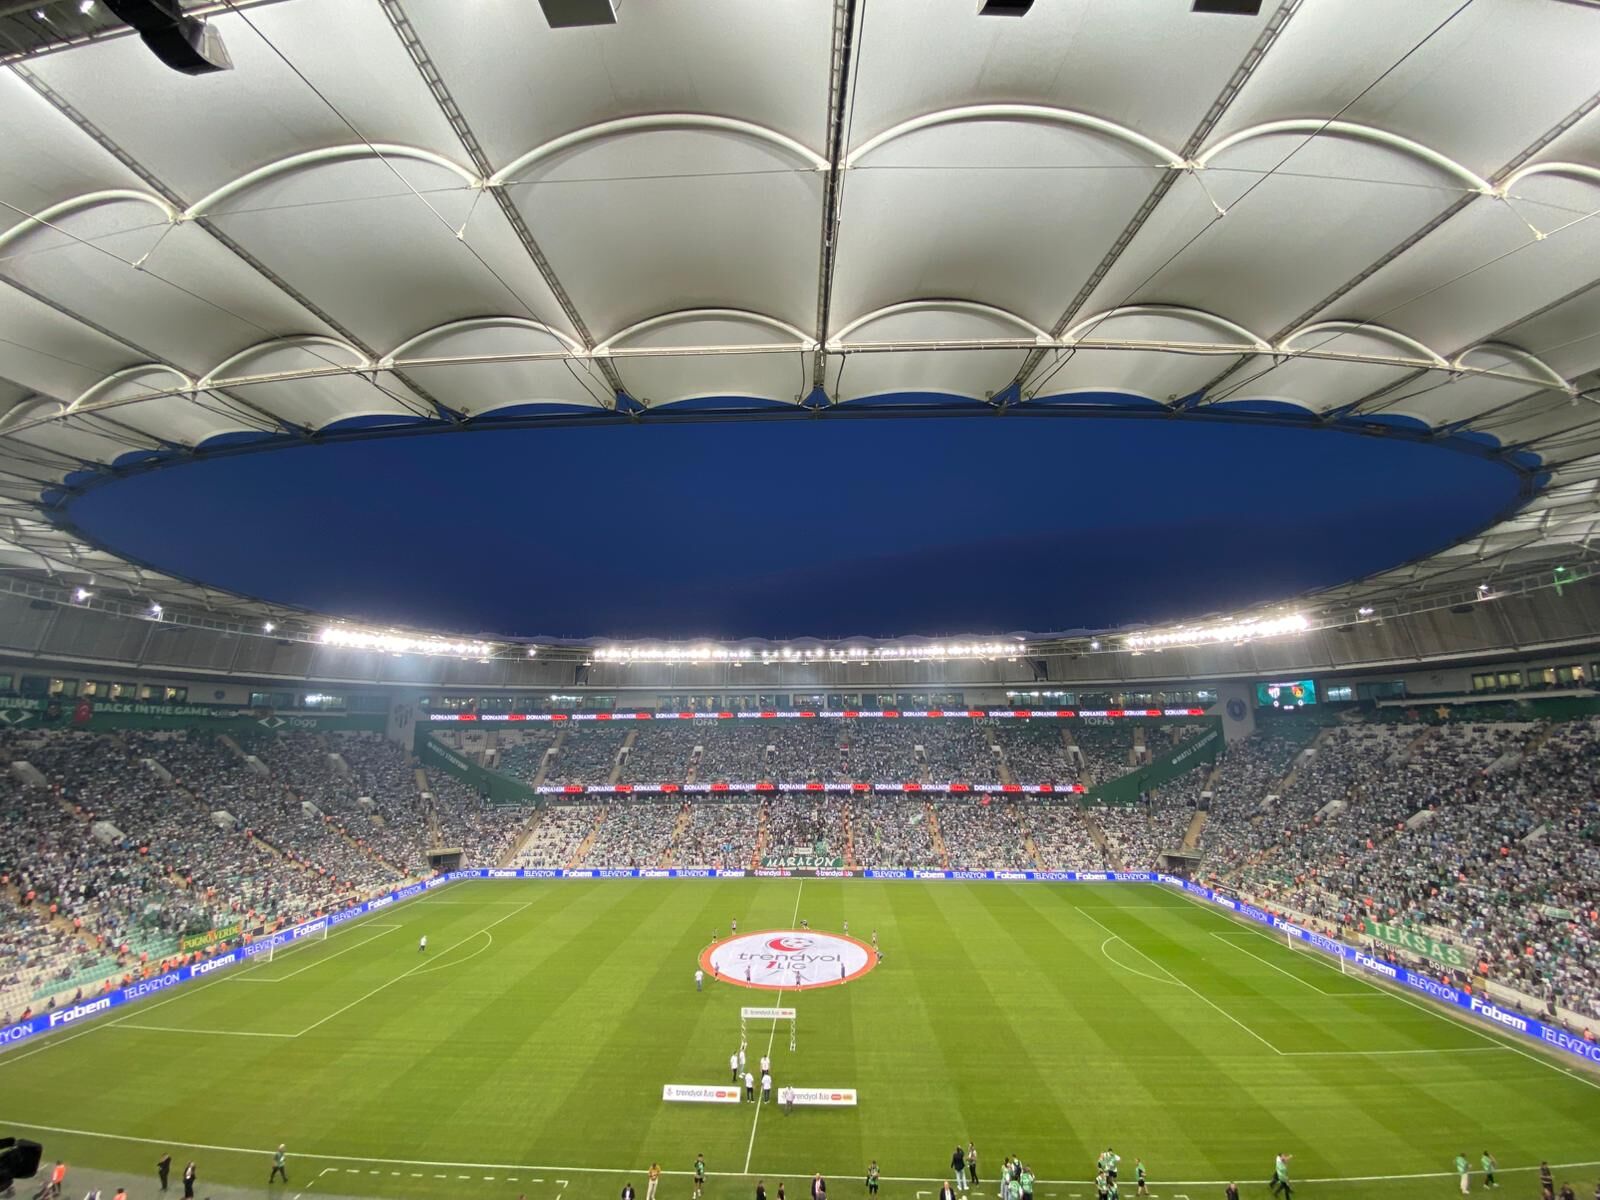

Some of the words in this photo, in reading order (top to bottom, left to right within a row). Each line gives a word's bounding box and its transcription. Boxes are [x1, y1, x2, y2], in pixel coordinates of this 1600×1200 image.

[94, 703, 134, 713] BACK
[135, 704, 149, 714] IN
[149, 705, 174, 715] THE
[175, 706, 209, 716] GAME
[289, 717, 317, 728] Togg
[766, 856, 836, 867] MARATON
[1373, 922, 1461, 965] TEKSAS
[739, 953, 841, 963] trendyol
